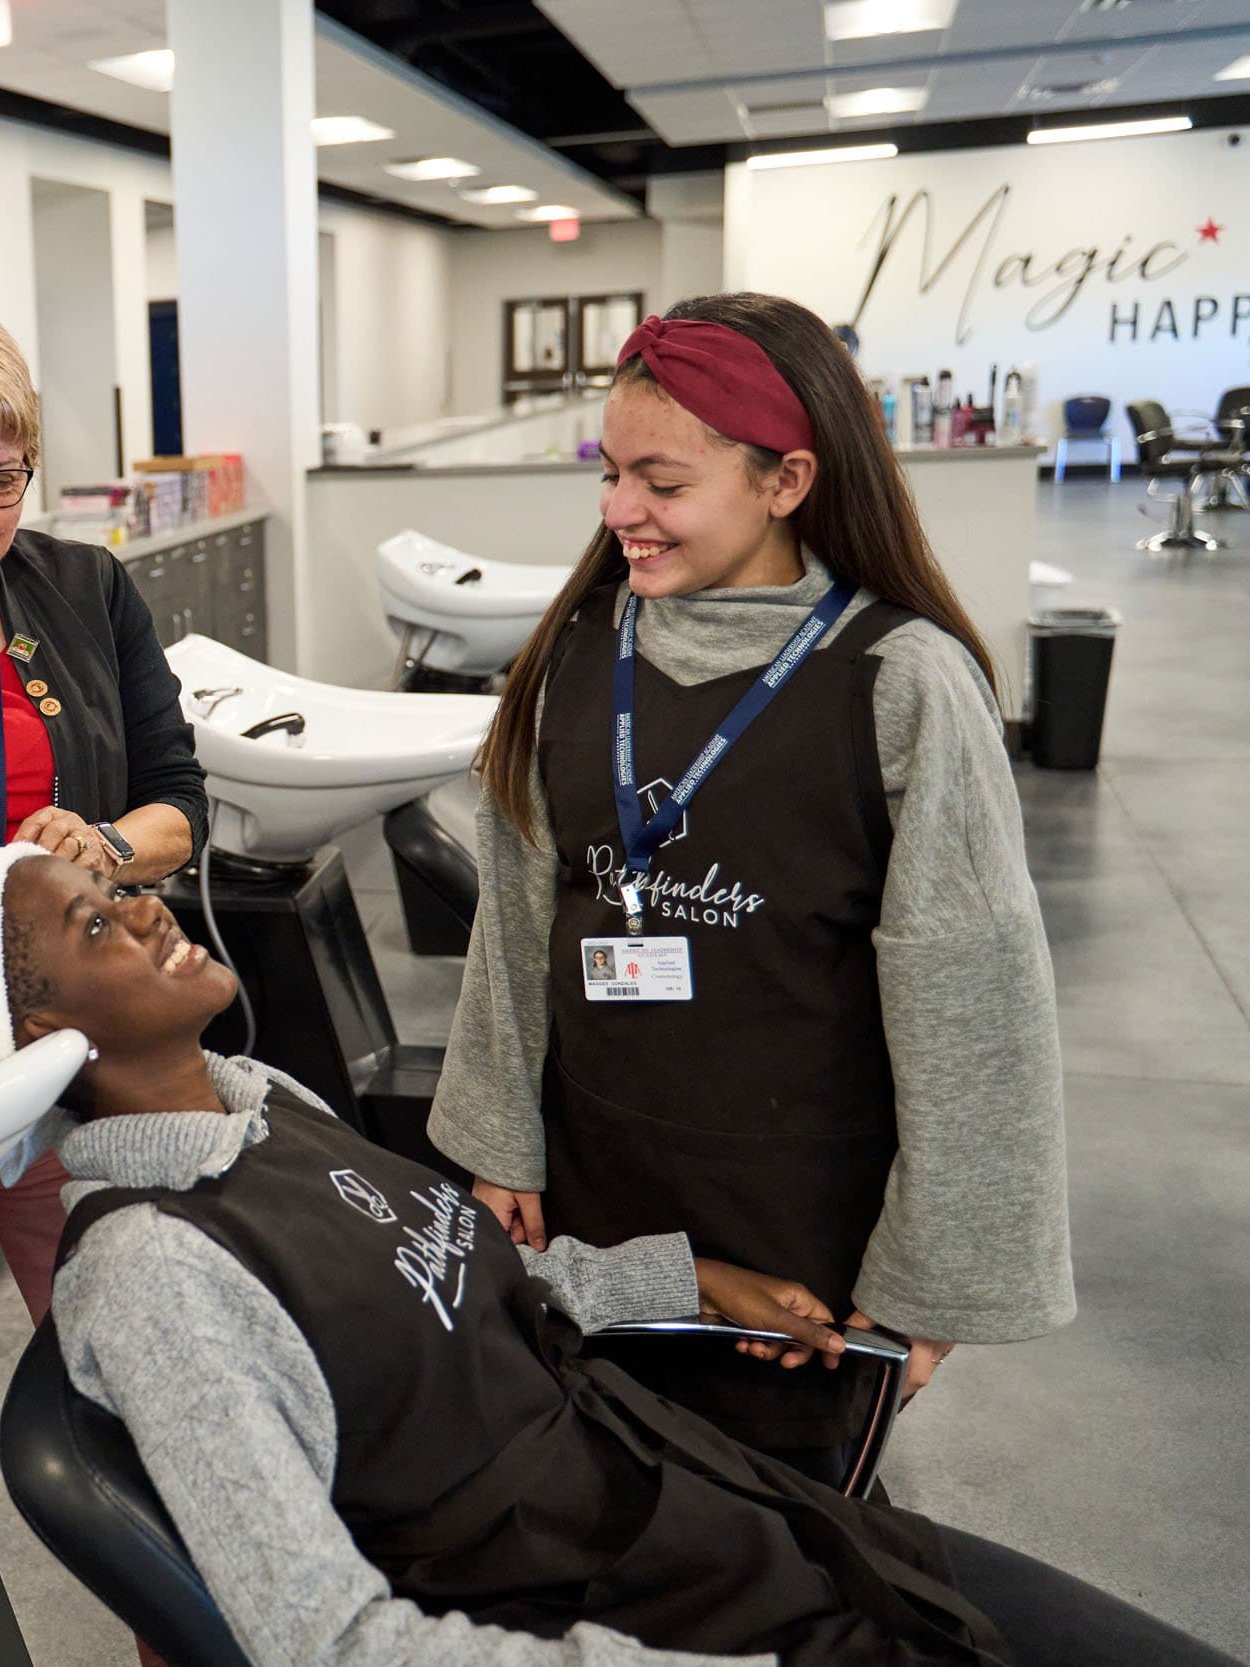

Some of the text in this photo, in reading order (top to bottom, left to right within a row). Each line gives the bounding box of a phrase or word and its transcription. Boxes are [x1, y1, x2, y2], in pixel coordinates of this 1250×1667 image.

[852, 183, 1190, 347] Magic
[1109, 294, 1250, 343] HAPP
[766, 619, 825, 688] APPLIED TECHNOLOGIES
[674, 736, 727, 805] APPLIED TECHNOLOGIES
[662, 902, 738, 928] SALON
[394, 1183, 465, 1331] Pathfinders
[455, 1205, 477, 1251] SALON
